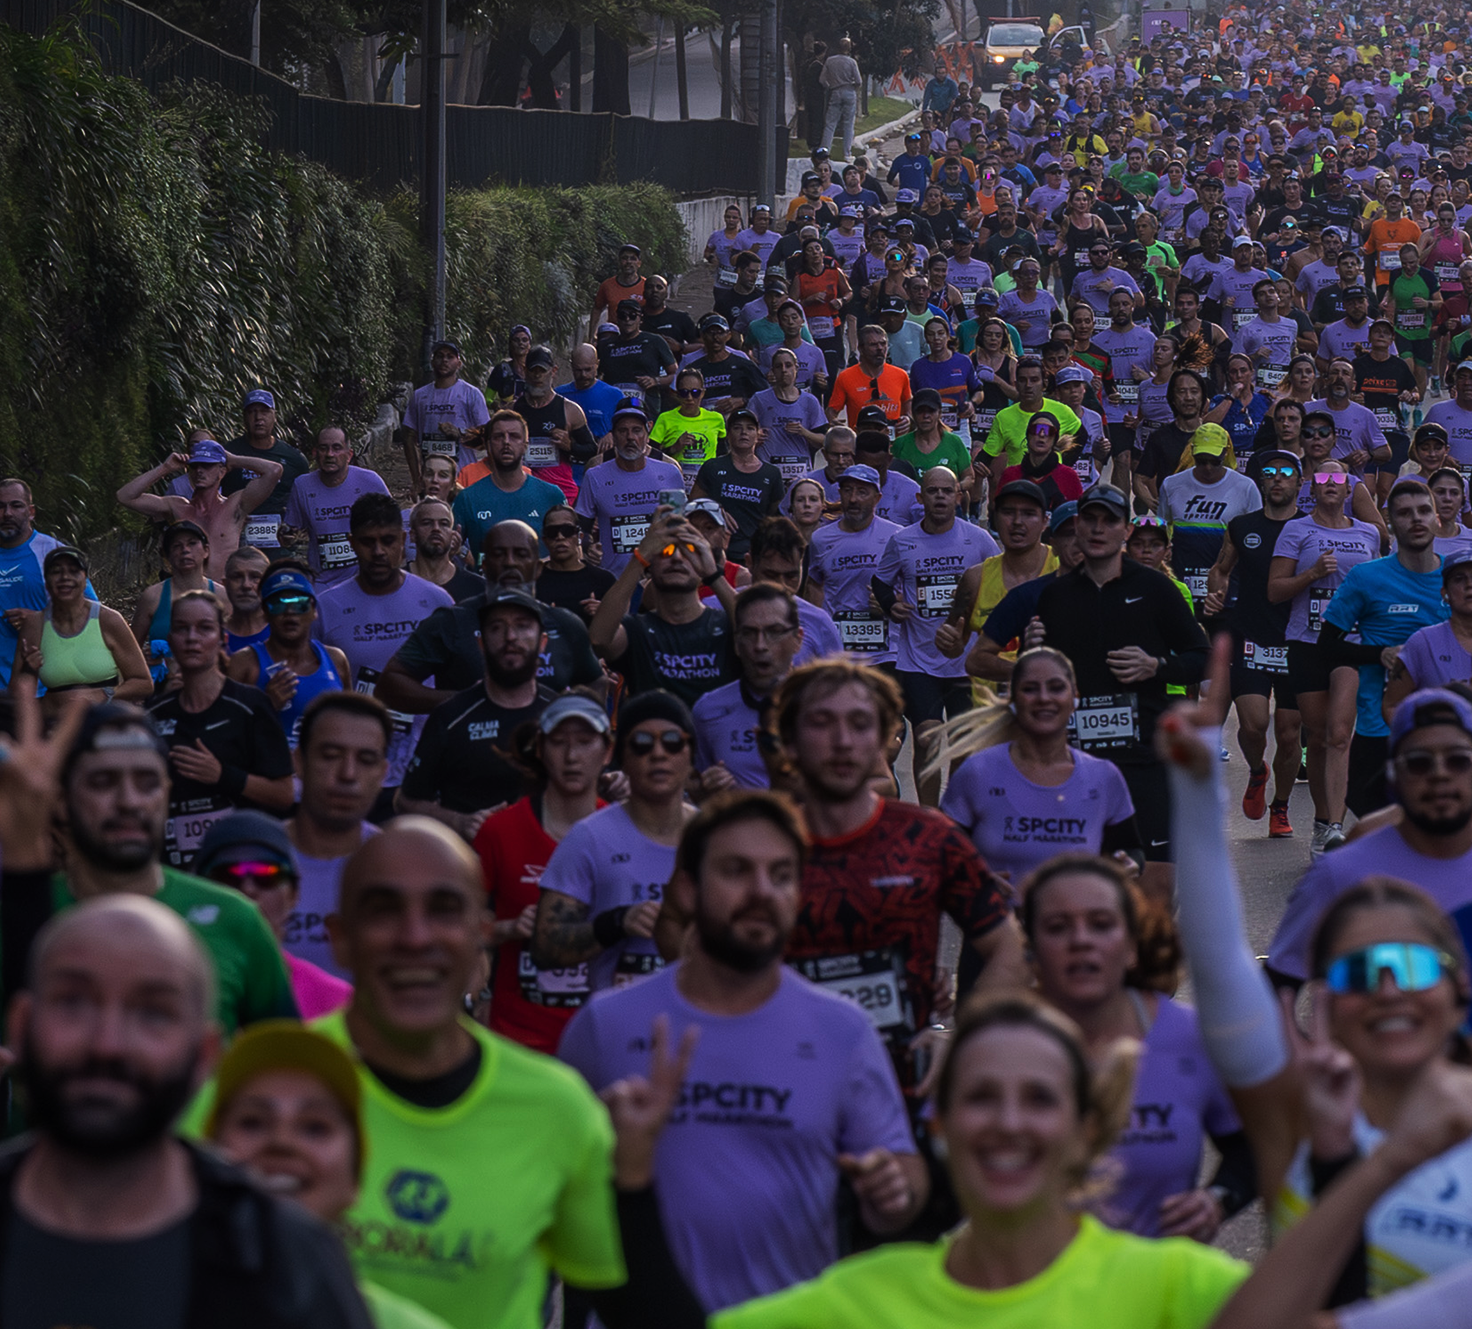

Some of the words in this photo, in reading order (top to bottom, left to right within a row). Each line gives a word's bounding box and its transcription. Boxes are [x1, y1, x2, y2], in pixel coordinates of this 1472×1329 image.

[782, 465, 804, 474] 13517
[728, 484, 762, 496] SPCITY
[621, 490, 659, 501] SPCITY
[721, 490, 761, 503] MARATHON
[1184, 495, 1227, 520] fun
[248, 526, 276, 535] 23885
[613, 528, 619, 537] D
[1327, 540, 1366, 549] SPCITY
[838, 555, 877, 565] SPCITY
[924, 556, 964, 567] SPCITY
[919, 590, 924, 599] E
[1312, 602, 1318, 611] D
[365, 621, 418, 634] SPCITY
[845, 625, 881, 635] 13395
[1246, 644, 1253, 653] B
[663, 653, 716, 668] SPCITY
[359, 682, 365, 692] D
[1082, 713, 1129, 729] 10945
[1018, 818, 1085, 833] SPCITY
